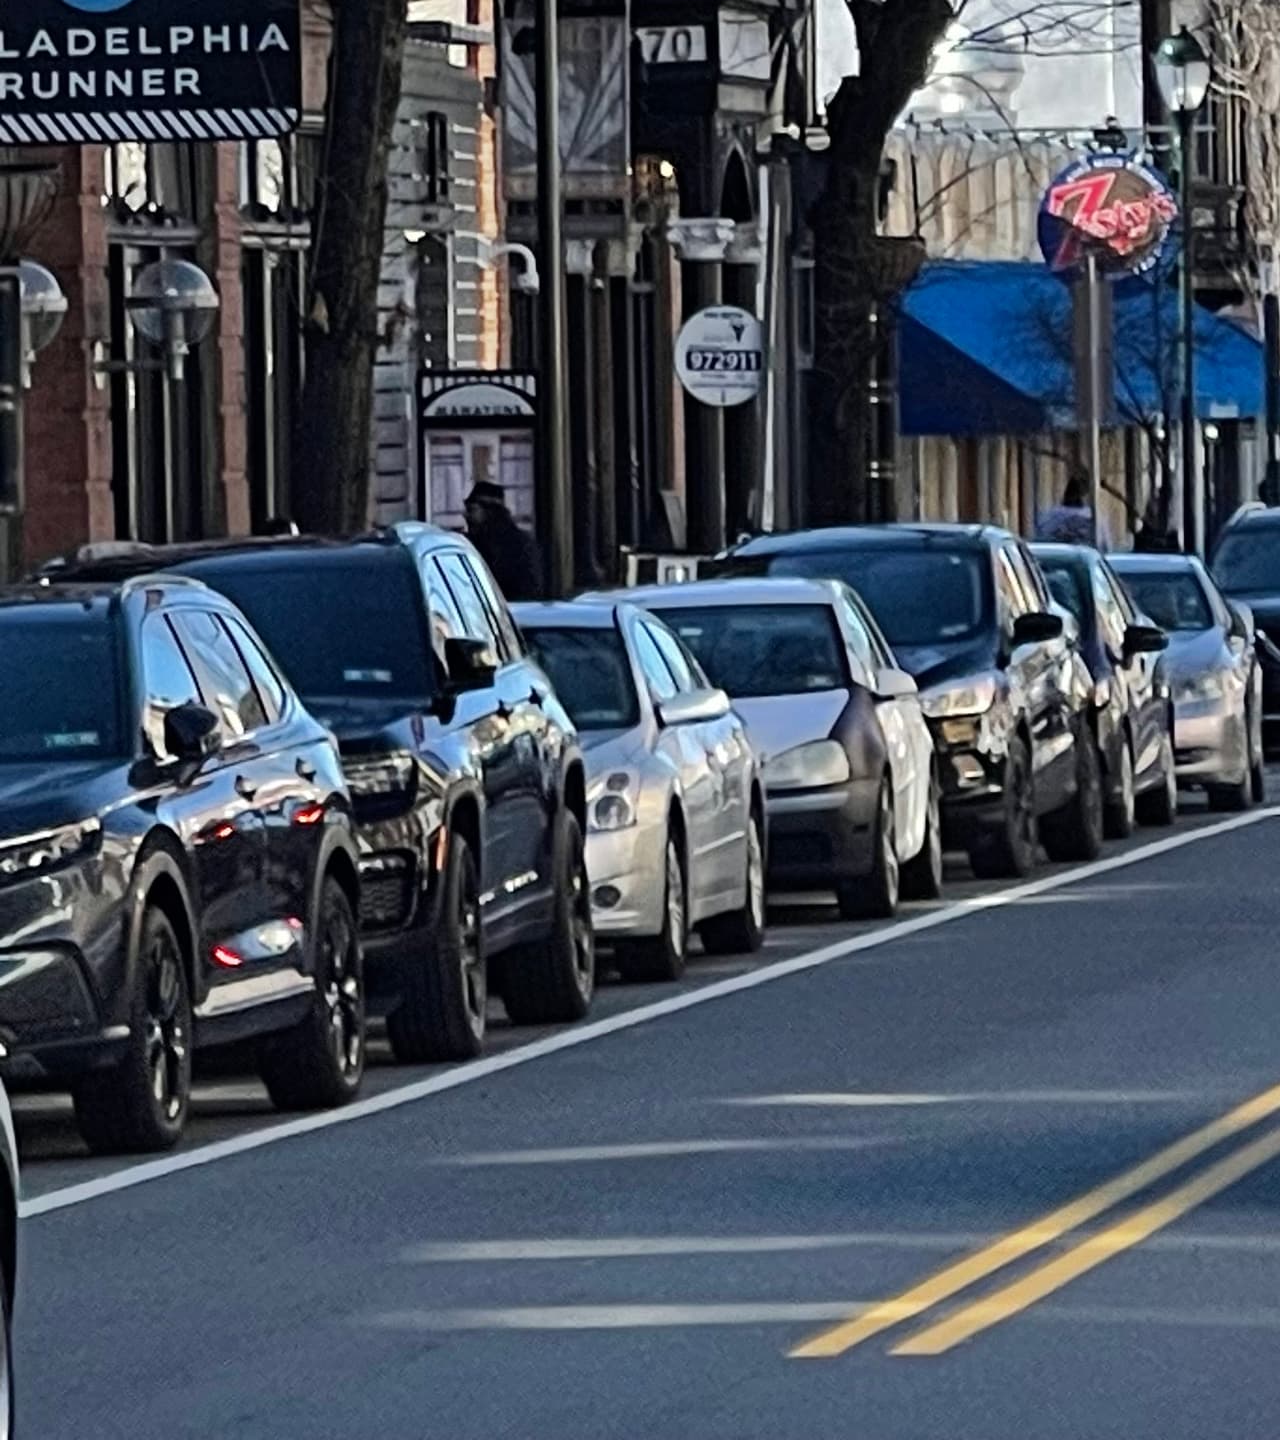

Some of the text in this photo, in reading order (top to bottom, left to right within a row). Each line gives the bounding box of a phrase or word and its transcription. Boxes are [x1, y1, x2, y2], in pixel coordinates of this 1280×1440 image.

[644, 28, 692, 62] 70
[0, 67, 202, 101] RUNNER
[690, 351, 757, 371] 972911
